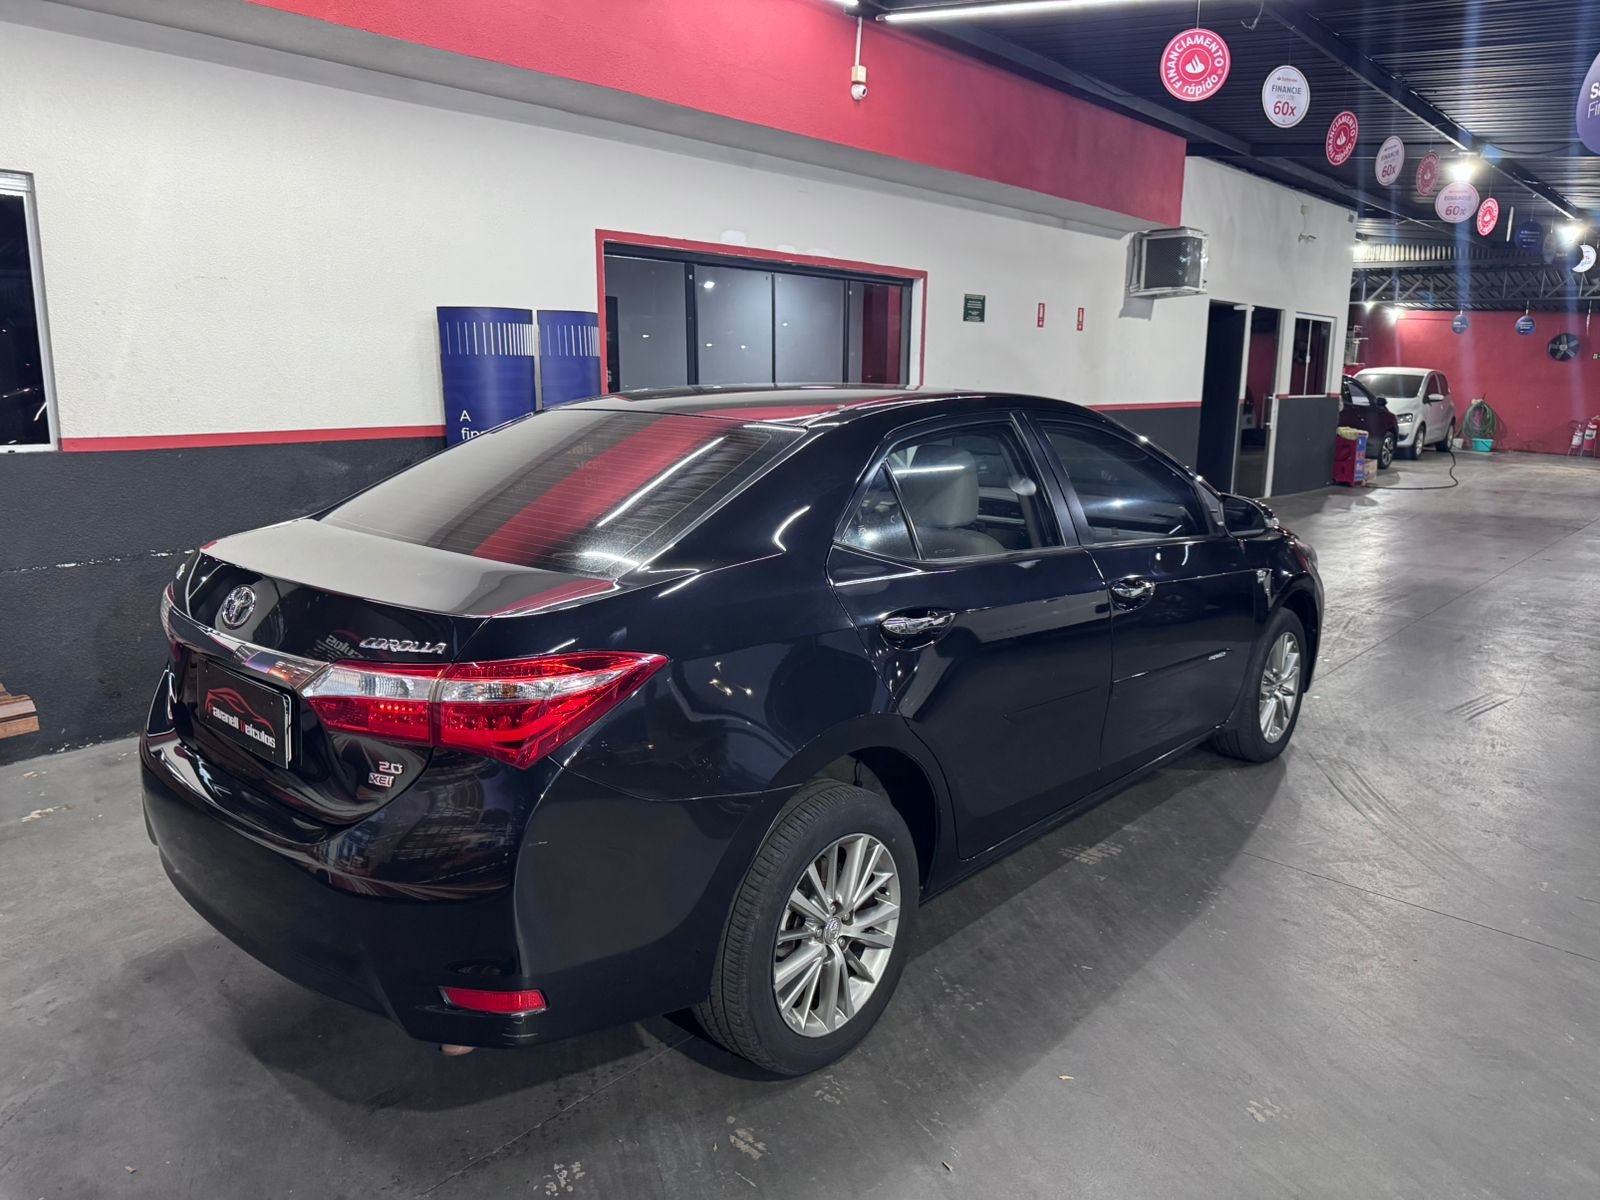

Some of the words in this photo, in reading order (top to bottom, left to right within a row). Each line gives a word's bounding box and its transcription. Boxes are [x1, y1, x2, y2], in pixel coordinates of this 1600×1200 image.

[1167, 35, 1224, 88] FINANCIAMENTO
[1183, 74, 1219, 97] rápido
[1272, 85, 1302, 95] FINANCIE
[1273, 100, 1297, 117] 60x
[1382, 164, 1396, 178] 60x
[1445, 205, 1467, 216] 60x
[460, 410, 472, 422] A
[359, 637, 447, 655] COROLLA
